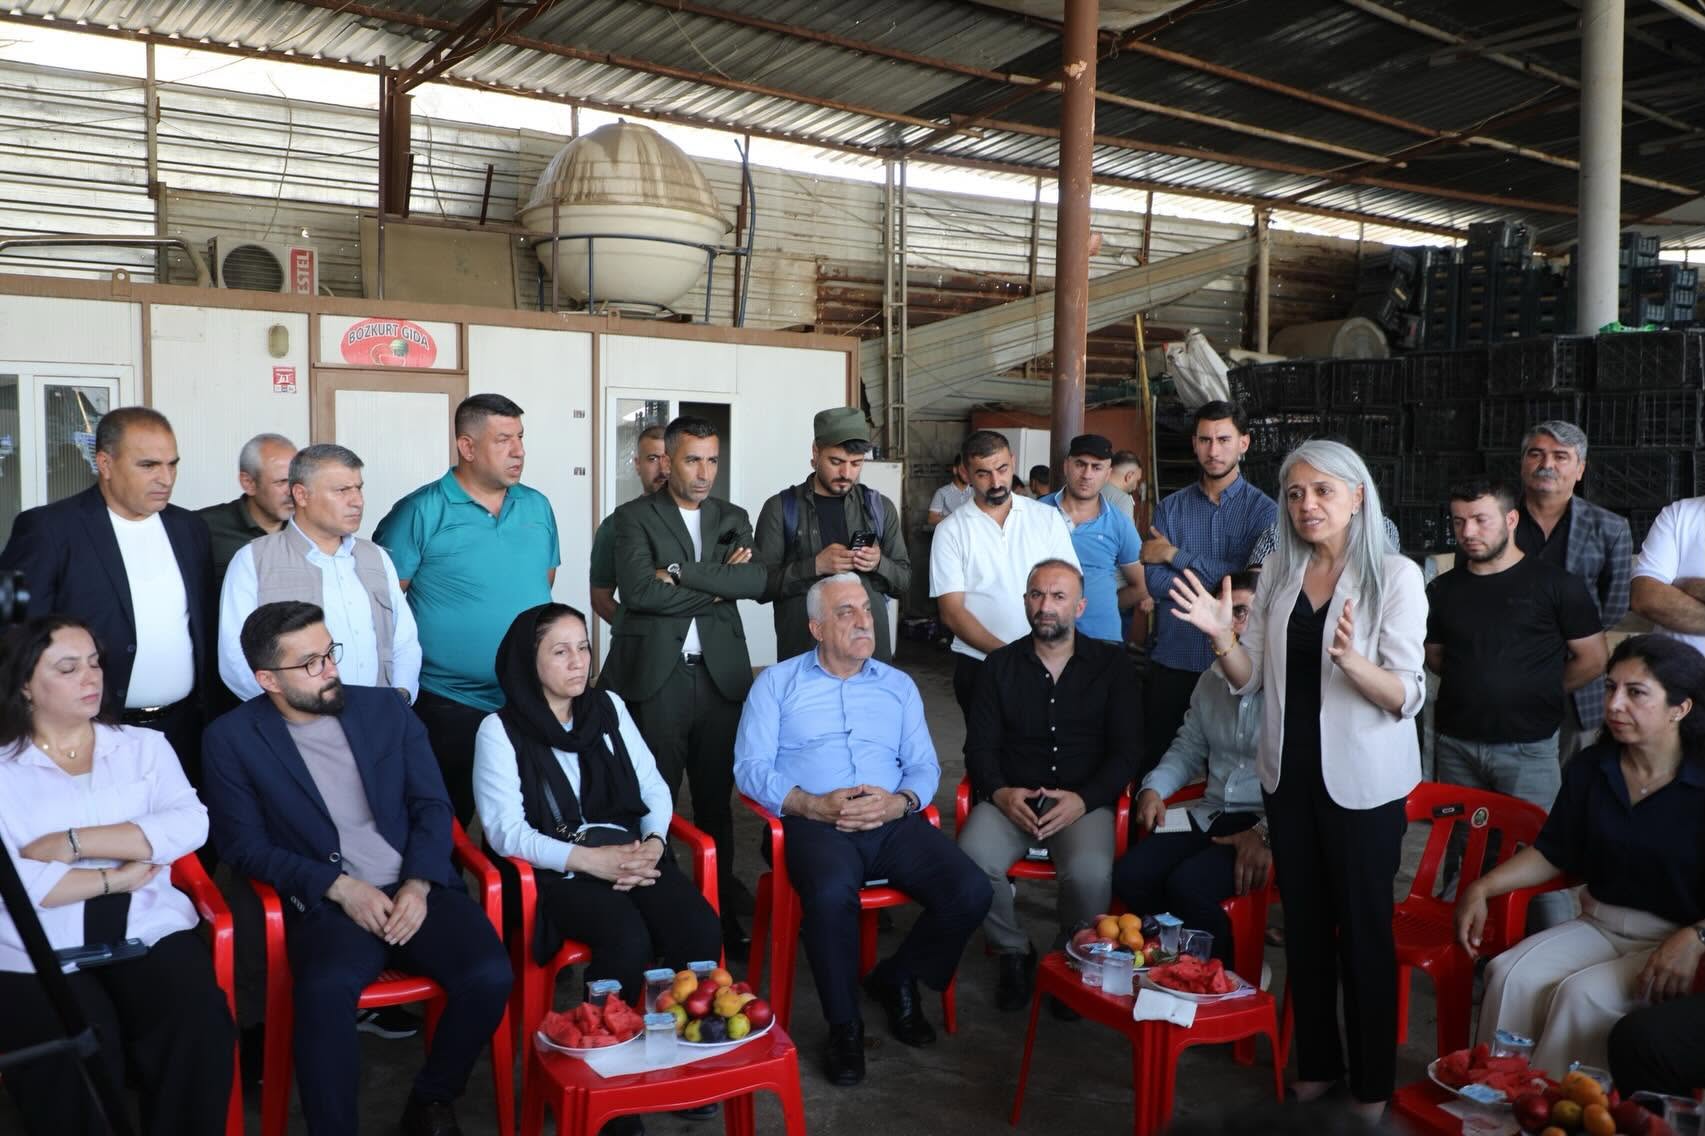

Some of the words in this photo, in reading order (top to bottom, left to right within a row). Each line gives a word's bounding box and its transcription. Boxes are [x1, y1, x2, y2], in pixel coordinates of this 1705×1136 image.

[296, 252, 310, 295] ESTEL
[348, 323, 398, 344] BOZKURT
[402, 326, 429, 348] GIDA
